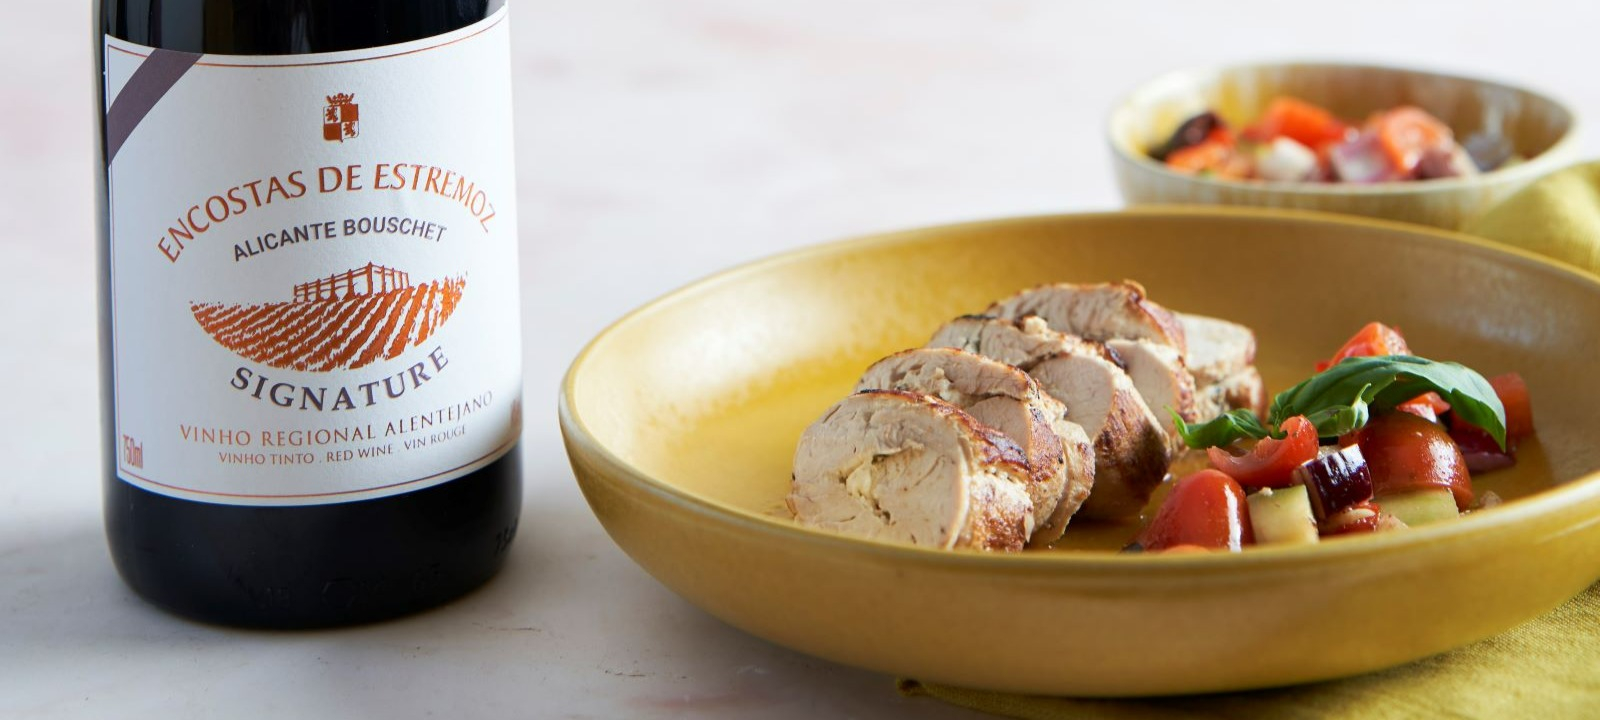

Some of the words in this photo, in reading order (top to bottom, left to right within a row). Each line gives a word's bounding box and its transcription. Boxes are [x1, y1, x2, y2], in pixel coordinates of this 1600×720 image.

[158, 169, 307, 262] ENCOSTAS
[318, 164, 363, 193] DE
[374, 163, 497, 233] ESTREMOZ
[233, 221, 336, 261] ALICANTE
[343, 216, 447, 243] BOUSCHET
[230, 346, 450, 412] SIGNATURE
[179, 424, 252, 446] VINHO
[261, 425, 376, 447] REGIONAL
[384, 390, 494, 437] ALENTEJANO
[218, 452, 266, 465] VINHO
[270, 453, 315, 465] TINTO
[326, 451, 353, 463] RED
[357, 445, 394, 457] WINE
[403, 437, 427, 451] VIN
[430, 425, 467, 445] ROUGE
